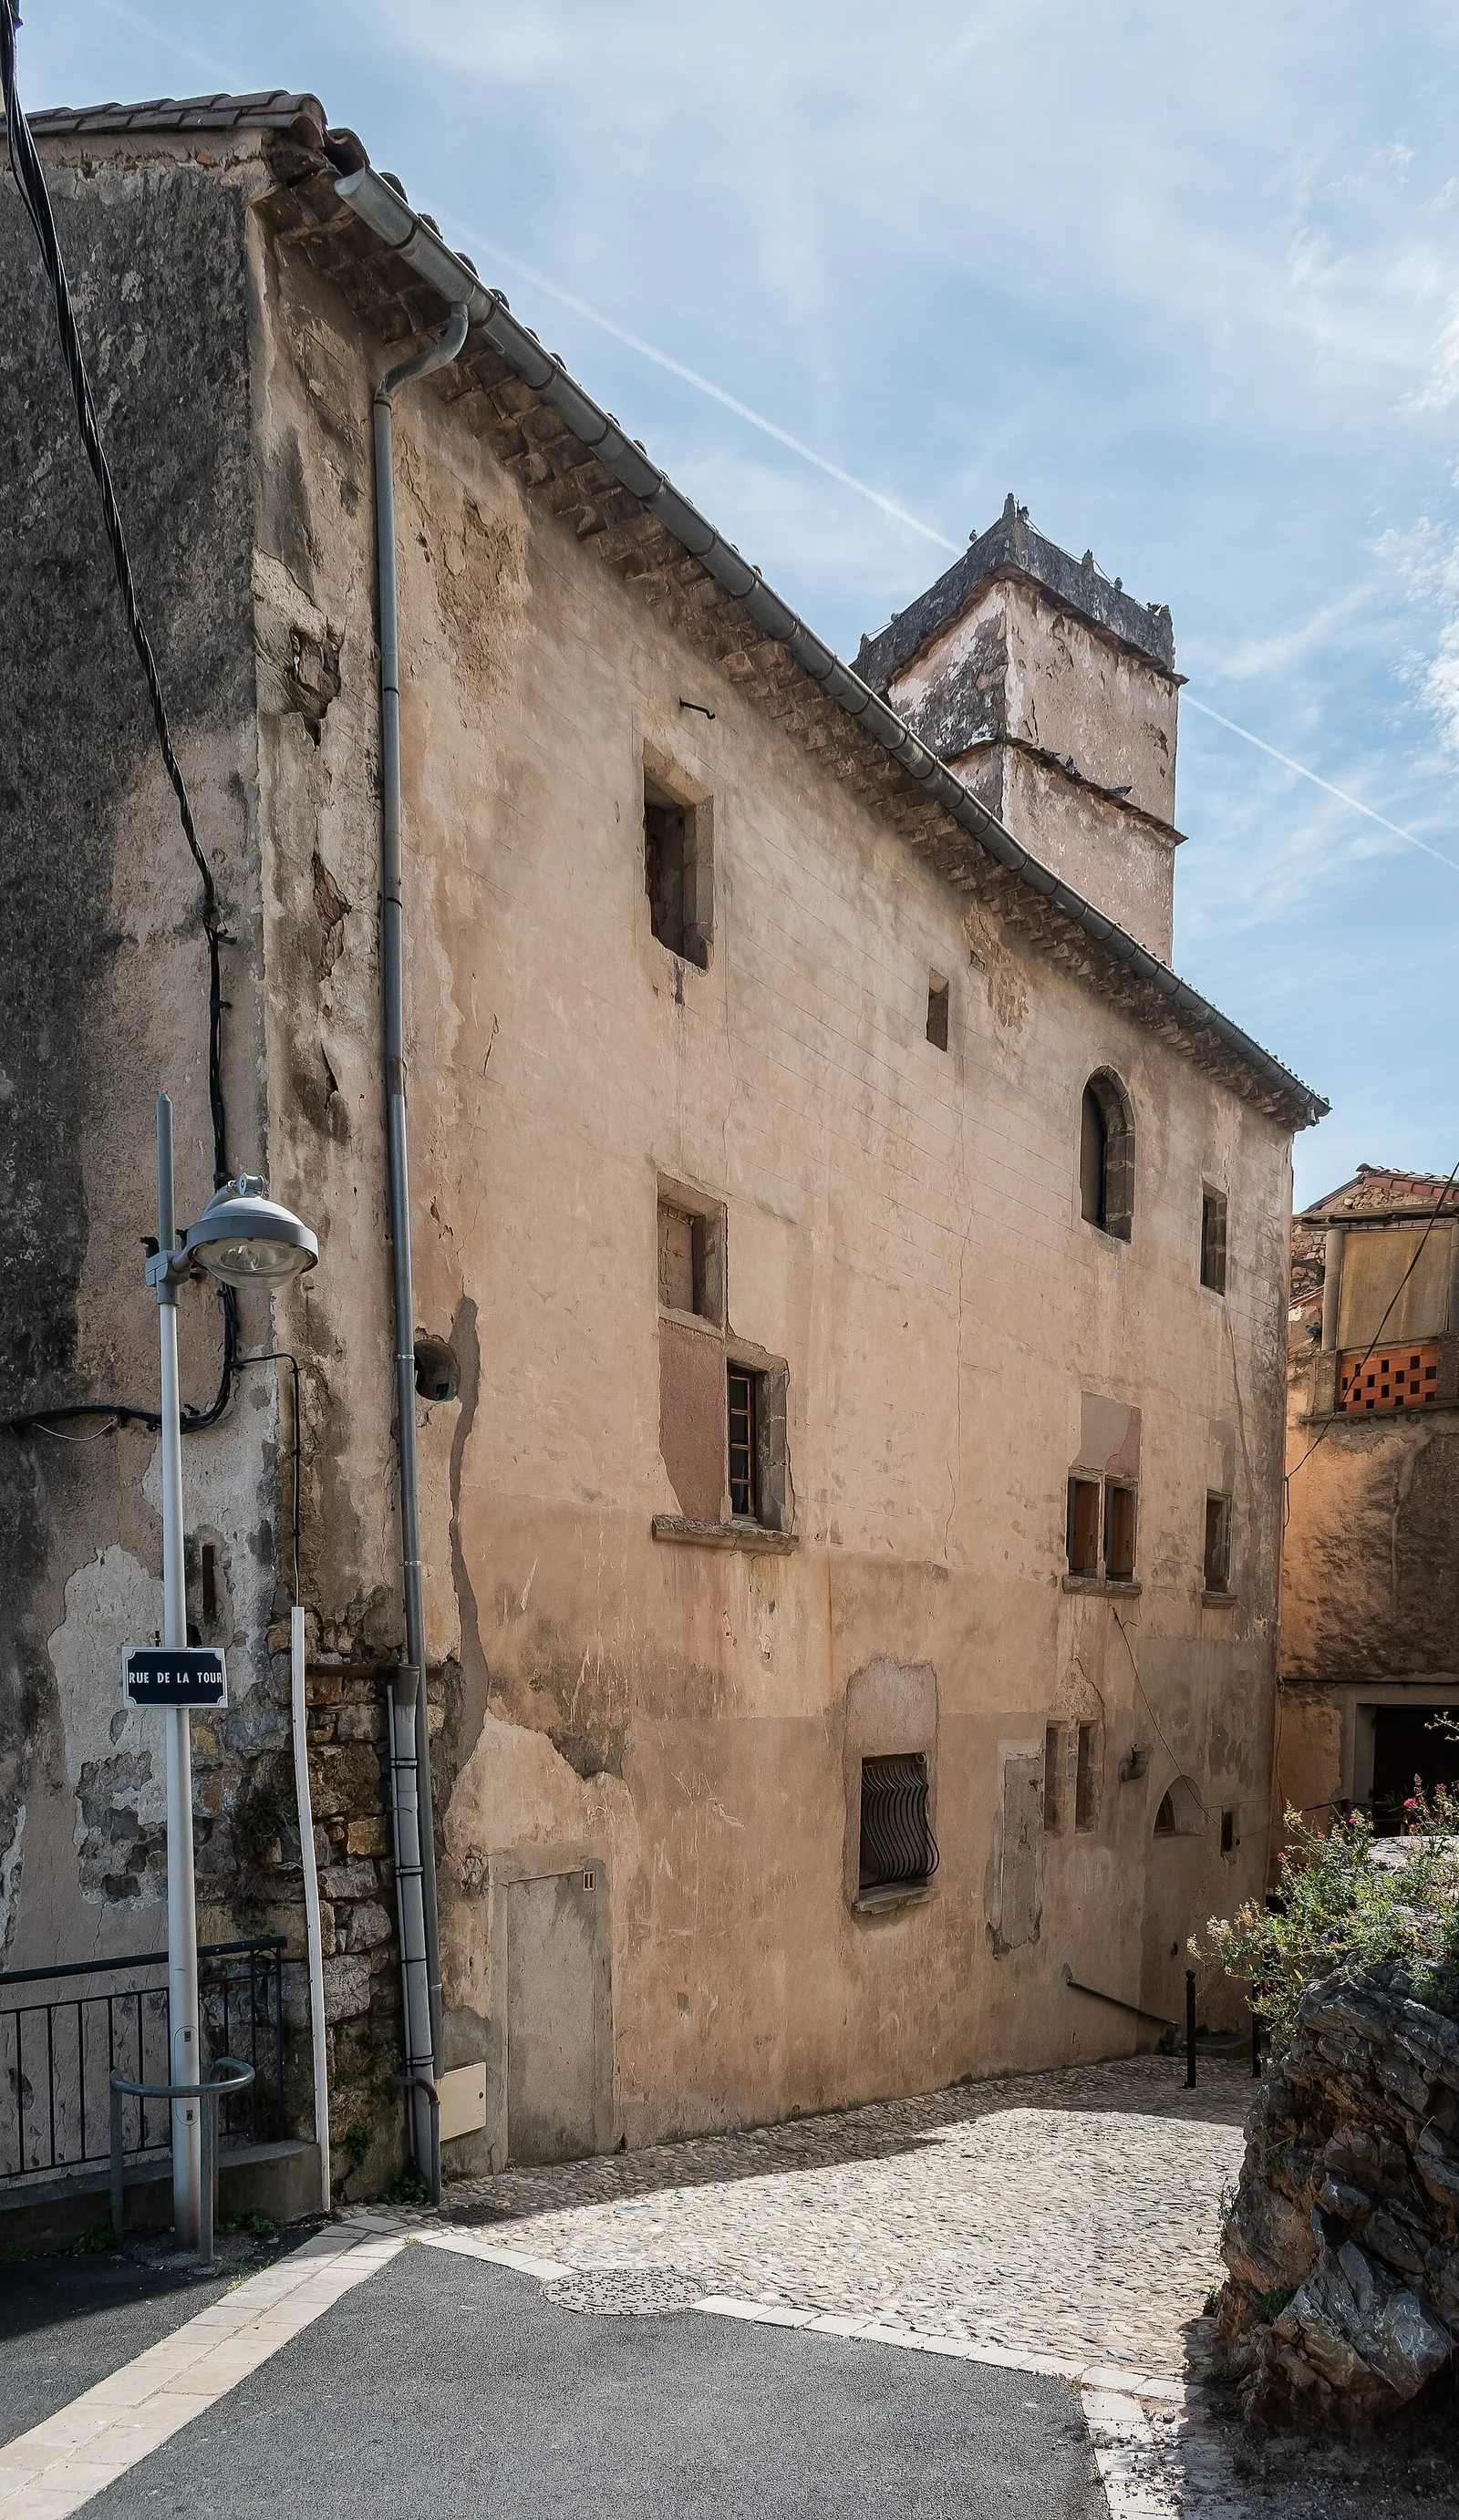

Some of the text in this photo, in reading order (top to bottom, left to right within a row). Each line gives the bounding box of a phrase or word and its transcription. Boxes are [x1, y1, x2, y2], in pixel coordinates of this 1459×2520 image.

[129, 1672, 222, 1684] RUE DE LA TOUR
